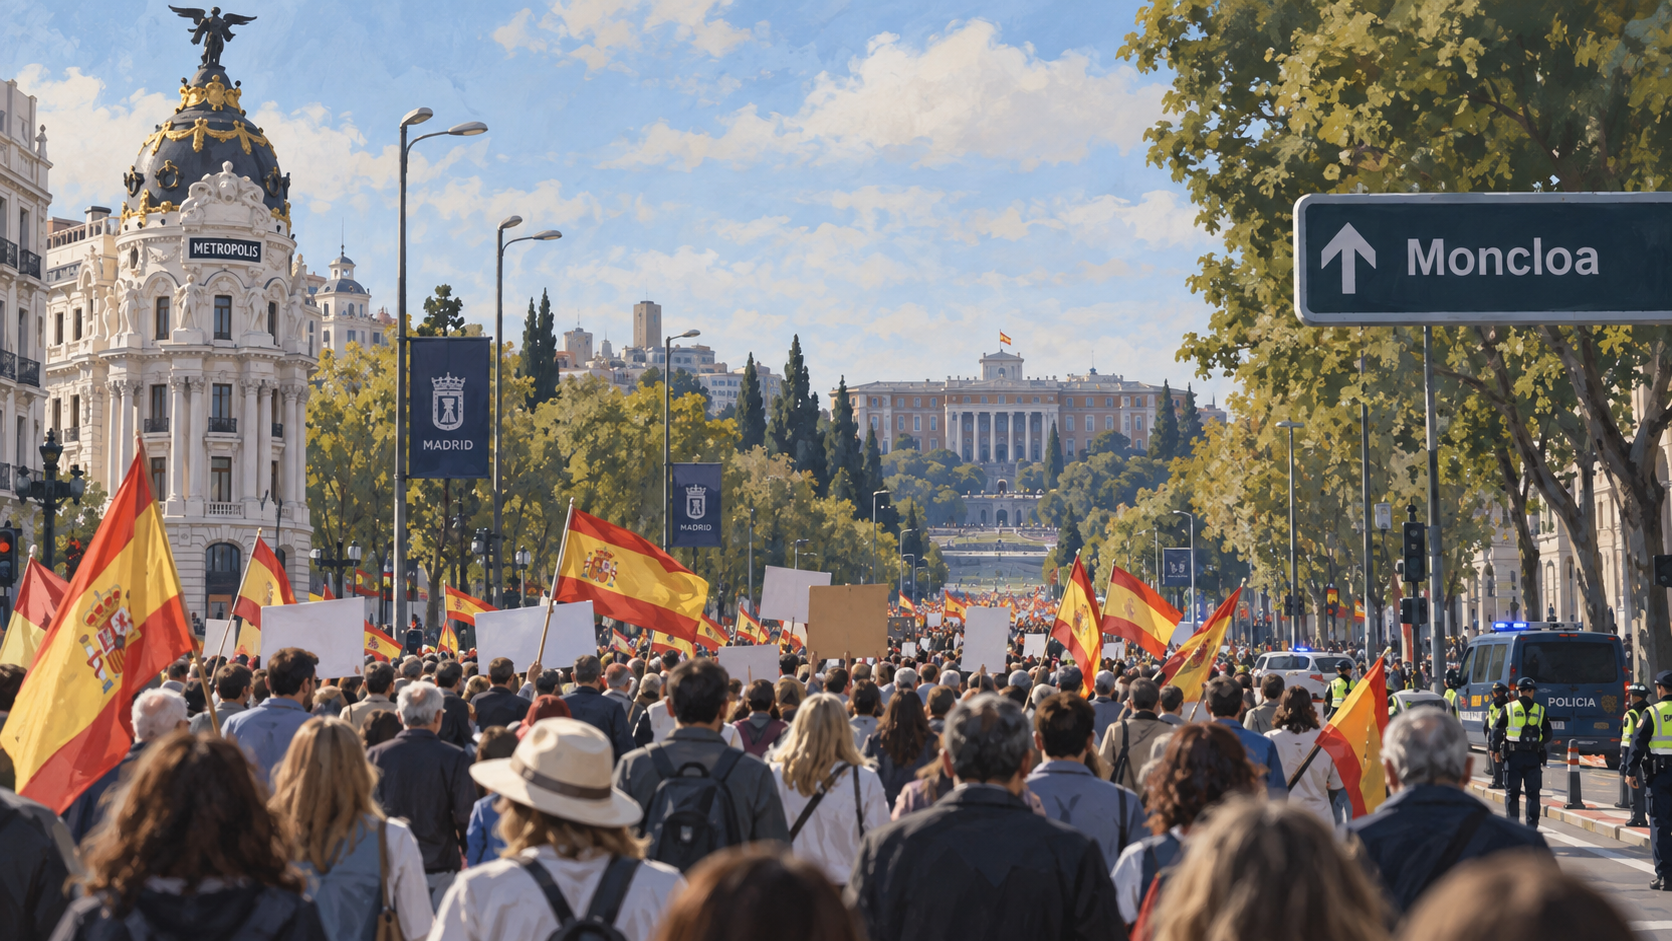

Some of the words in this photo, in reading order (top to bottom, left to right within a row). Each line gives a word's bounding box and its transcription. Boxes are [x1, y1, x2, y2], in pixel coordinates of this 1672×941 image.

[194, 242, 258, 258] METROPOLIS
[1407, 237, 1600, 276] Moncloa
[423, 439, 474, 451] MADRID
[680, 523, 712, 531] MADRID
[1547, 697, 1597, 708] POLICIA
